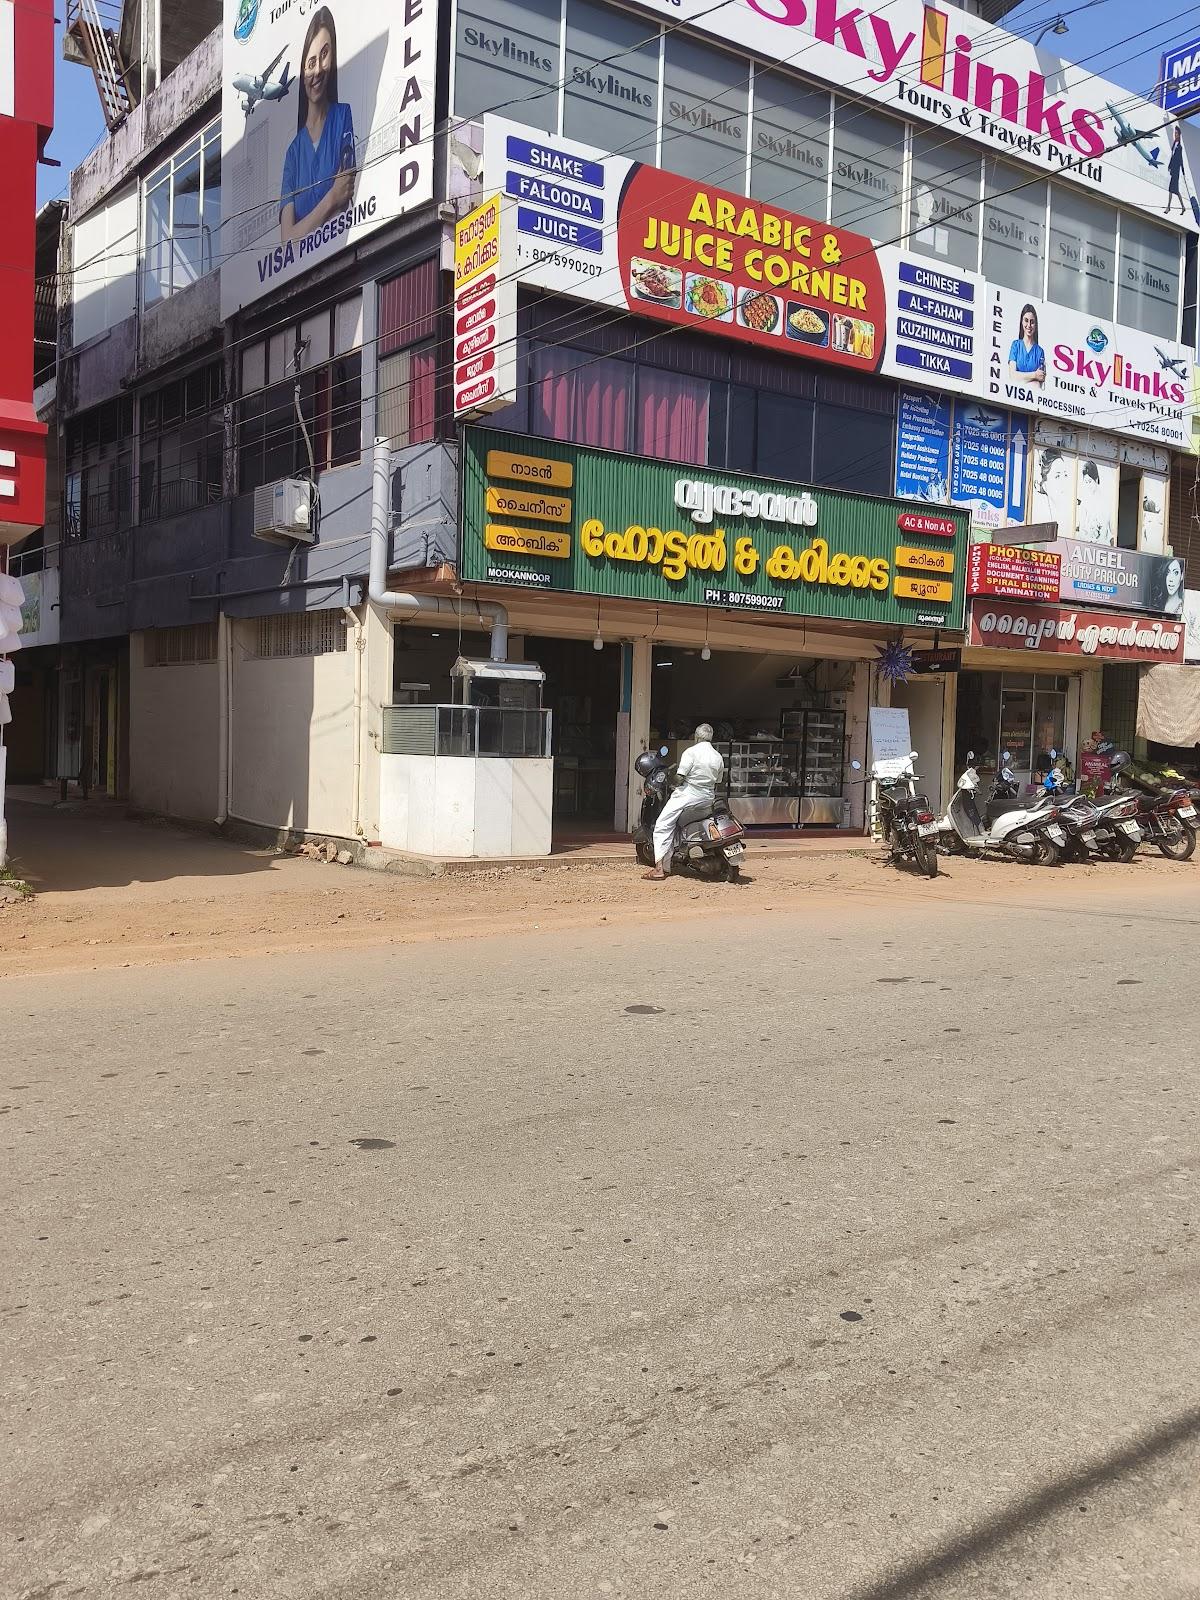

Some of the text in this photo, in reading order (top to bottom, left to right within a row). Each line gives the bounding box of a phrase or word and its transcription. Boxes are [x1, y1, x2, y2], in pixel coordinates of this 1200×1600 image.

[464, 28, 552, 72] Skylinks
[572, 66, 652, 107] Skylinks
[669, 101, 741, 138] Skylinks
[897, 79, 952, 119] Tours
[959, 106, 972, 127] &
[979, 113, 1041, 156] Travels
[530, 148, 583, 178] SHAKE
[757, 133, 823, 168] Skylinks
[837, 162, 898, 193] Skylinks
[520, 179, 592, 214] FALOODA
[932, 197, 973, 223] ylinks
[257, 195, 376, 283] VISA PROCESSING
[533, 216, 578, 242] JUICE
[688, 192, 842, 265] ARABIC &
[533, 248, 602, 277] 8075990207
[644, 217, 868, 311] JUICE CORNER
[1060, 242, 1106, 270] Skylnks
[915, 270, 960, 294] CHINESE
[909, 296, 963, 322] AL-FAHAM
[900, 321, 971, 351] KUZHIMANTHI
[989, 290, 1003, 394] IRELAND
[920, 353, 951, 372] TIKKA
[1053, 344, 1185, 404] Skylinks
[1005, 384, 1086, 416] VISA PROCESSING
[1053, 376, 1085, 395] Tours
[1089, 386, 1097, 398] &
[1108, 391, 1146, 411] Travels
[511, 463, 552, 479] നാടൻ
[497, 498, 566, 517] ചൈനീസ്
[904, 516, 916, 528] AC
[917, 518, 923, 529] &
[924, 520, 938, 531] Non
[496, 534, 563, 552] അറബിക്
[581, 518, 890, 590] ഹോട്ടൽ & കറിക്കട
[989, 546, 1059, 565] PHOTOSTAT
[909, 554, 944, 567] കറികൾ
[971, 546, 980, 593] PHOTOSTAT
[1071, 545, 1125, 570] ANGEL
[488, 568, 551, 583] MOOKANNOOR
[986, 577, 1059, 593] SPIRAL BINDING
[987, 570, 1059, 585] DOCUMENT SCANNING
[1060, 561, 1138, 588] EAUTY PARLOUR
[705, 589, 721, 601] PH
[729, 592, 784, 608] 8075990207
[994, 586, 1051, 599] LAMINATION
